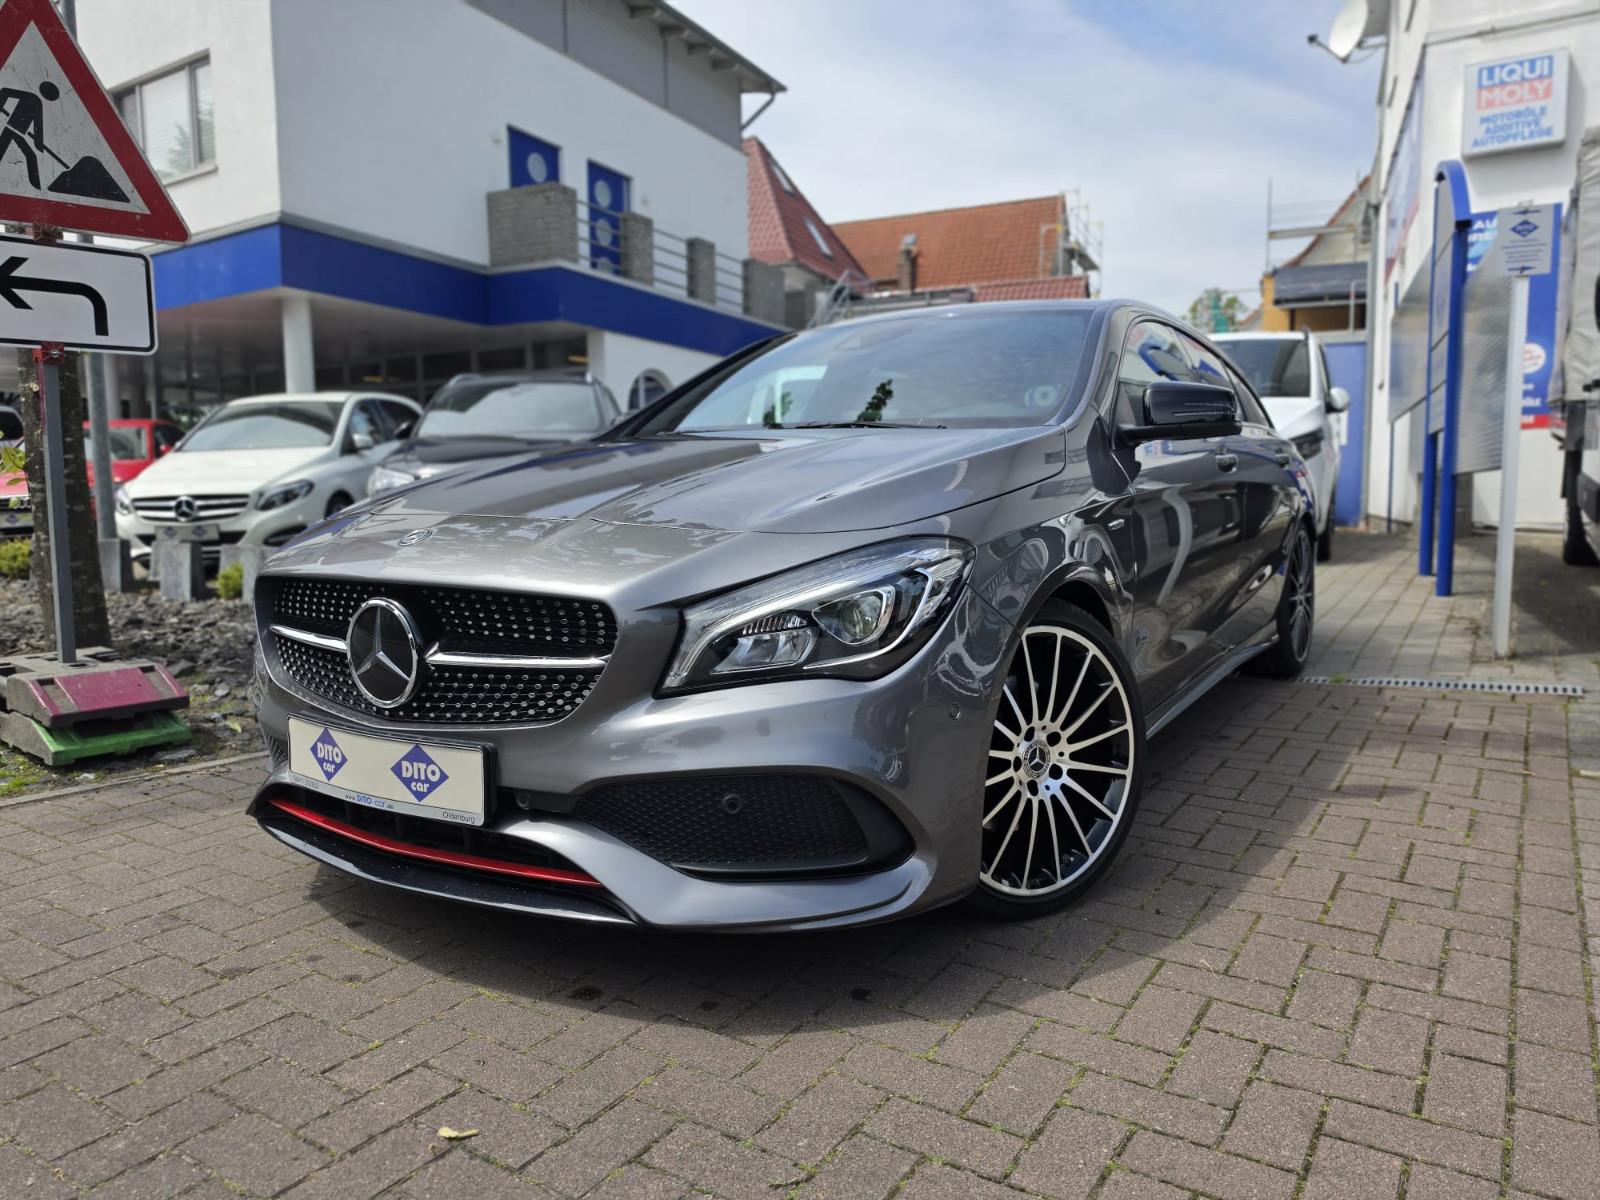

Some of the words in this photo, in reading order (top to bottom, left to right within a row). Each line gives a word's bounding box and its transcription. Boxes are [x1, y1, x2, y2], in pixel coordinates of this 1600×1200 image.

[1482, 58, 1549, 86] LIQUI
[1480, 78, 1551, 110] MOLY
[1471, 126, 1553, 149] AUTOPFLEGE
[1484, 118, 1542, 136] ADDITIVE
[316, 741, 342, 764] DITO
[322, 762, 336, 773] car
[401, 760, 441, 782] DITO
[410, 781, 430, 793] car
